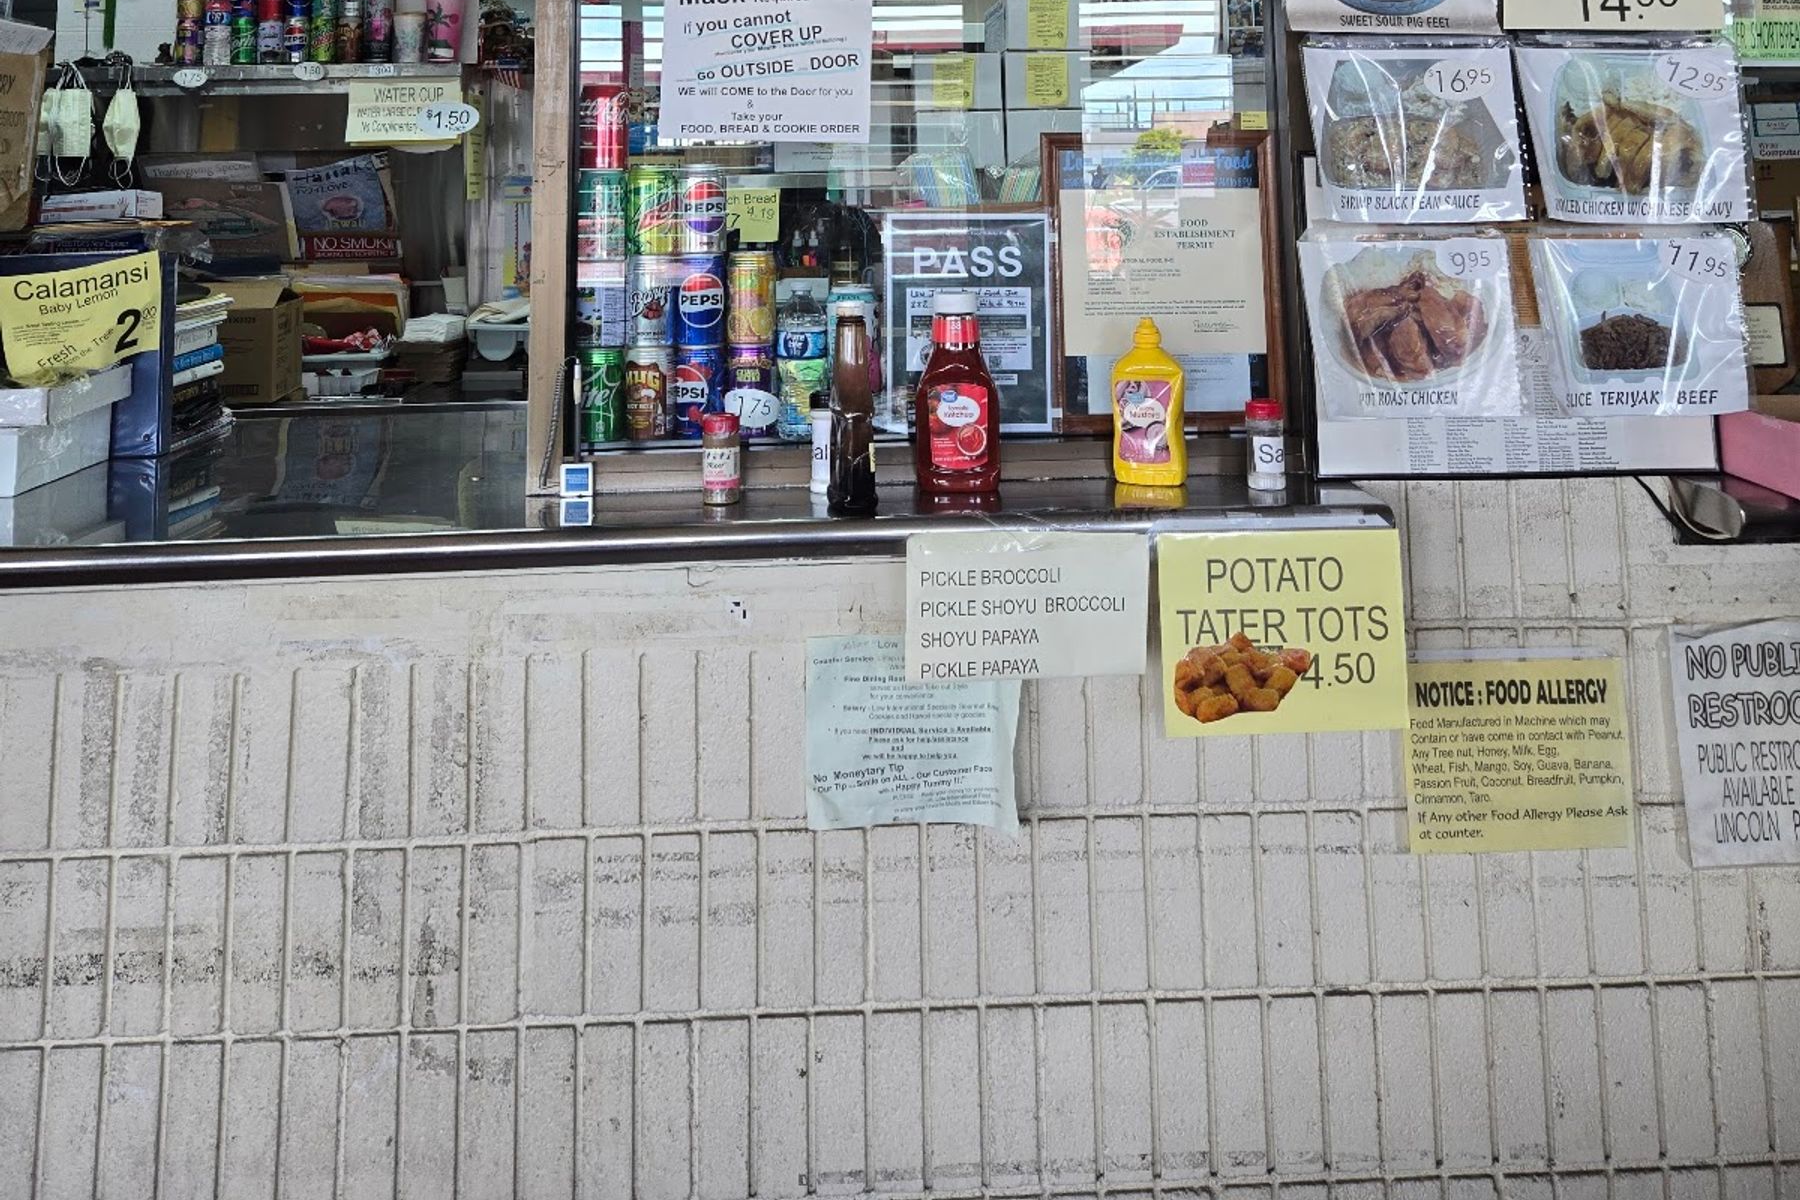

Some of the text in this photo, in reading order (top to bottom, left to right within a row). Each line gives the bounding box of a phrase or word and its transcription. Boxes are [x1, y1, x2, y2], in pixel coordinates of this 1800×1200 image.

[696, 10, 792, 38] you cannot
[1340, 15, 1450, 29] SWEET PIG FEET
[731, 29, 794, 49] COVER
[799, 25, 822, 41] UP
[721, 54, 859, 79] OUTSIDE DOOR
[374, 87, 414, 103] WATER
[721, 87, 853, 98] COME the Door you
[758, 113, 783, 123] your
[720, 124, 860, 133] BREAD COOKIE ORDER
[744, 193, 777, 205] Bread
[1582, 201, 1625, 215] CHICKEN
[1180, 219, 1208, 227] FOOD
[1154, 229, 1236, 238] ESTABLISHMENT
[914, 246, 1022, 278] PASS
[14, 261, 149, 301] Calamansi
[38, 288, 118, 315] Baby Lemon
[681, 293, 723, 307] PEPSI
[1411, 390, 1458, 406] CHICKEN
[1676, 390, 1719, 405] BEEF
[921, 568, 1060, 587] PICKLE BROCCOLI
[1207, 557, 1343, 593] POTATO
[921, 595, 1125, 617] PICKLE SHOYU BROCCOLI
[1176, 606, 1389, 644] TATER TOTS
[921, 629, 1040, 648] SHOYU PAPAYA
[921, 661, 976, 679] PICKLE
[982, 659, 1039, 676] PAPAYA
[1686, 644, 1726, 680] NO
[1486, 679, 1531, 705] FOOD
[1536, 678, 1607, 705] ALLERGY
[1437, 716, 1610, 728] Manufactured Machine which may
[1411, 734, 1447, 744] Contain
[1697, 742, 1747, 774] PUBLIC
[1722, 775, 1795, 808] AVAILABLE
[1429, 806, 1628, 824] Any other Food Allergy Please Ask
[1435, 828, 1484, 839] counter.
[1714, 810, 1781, 844] LINCOLN
